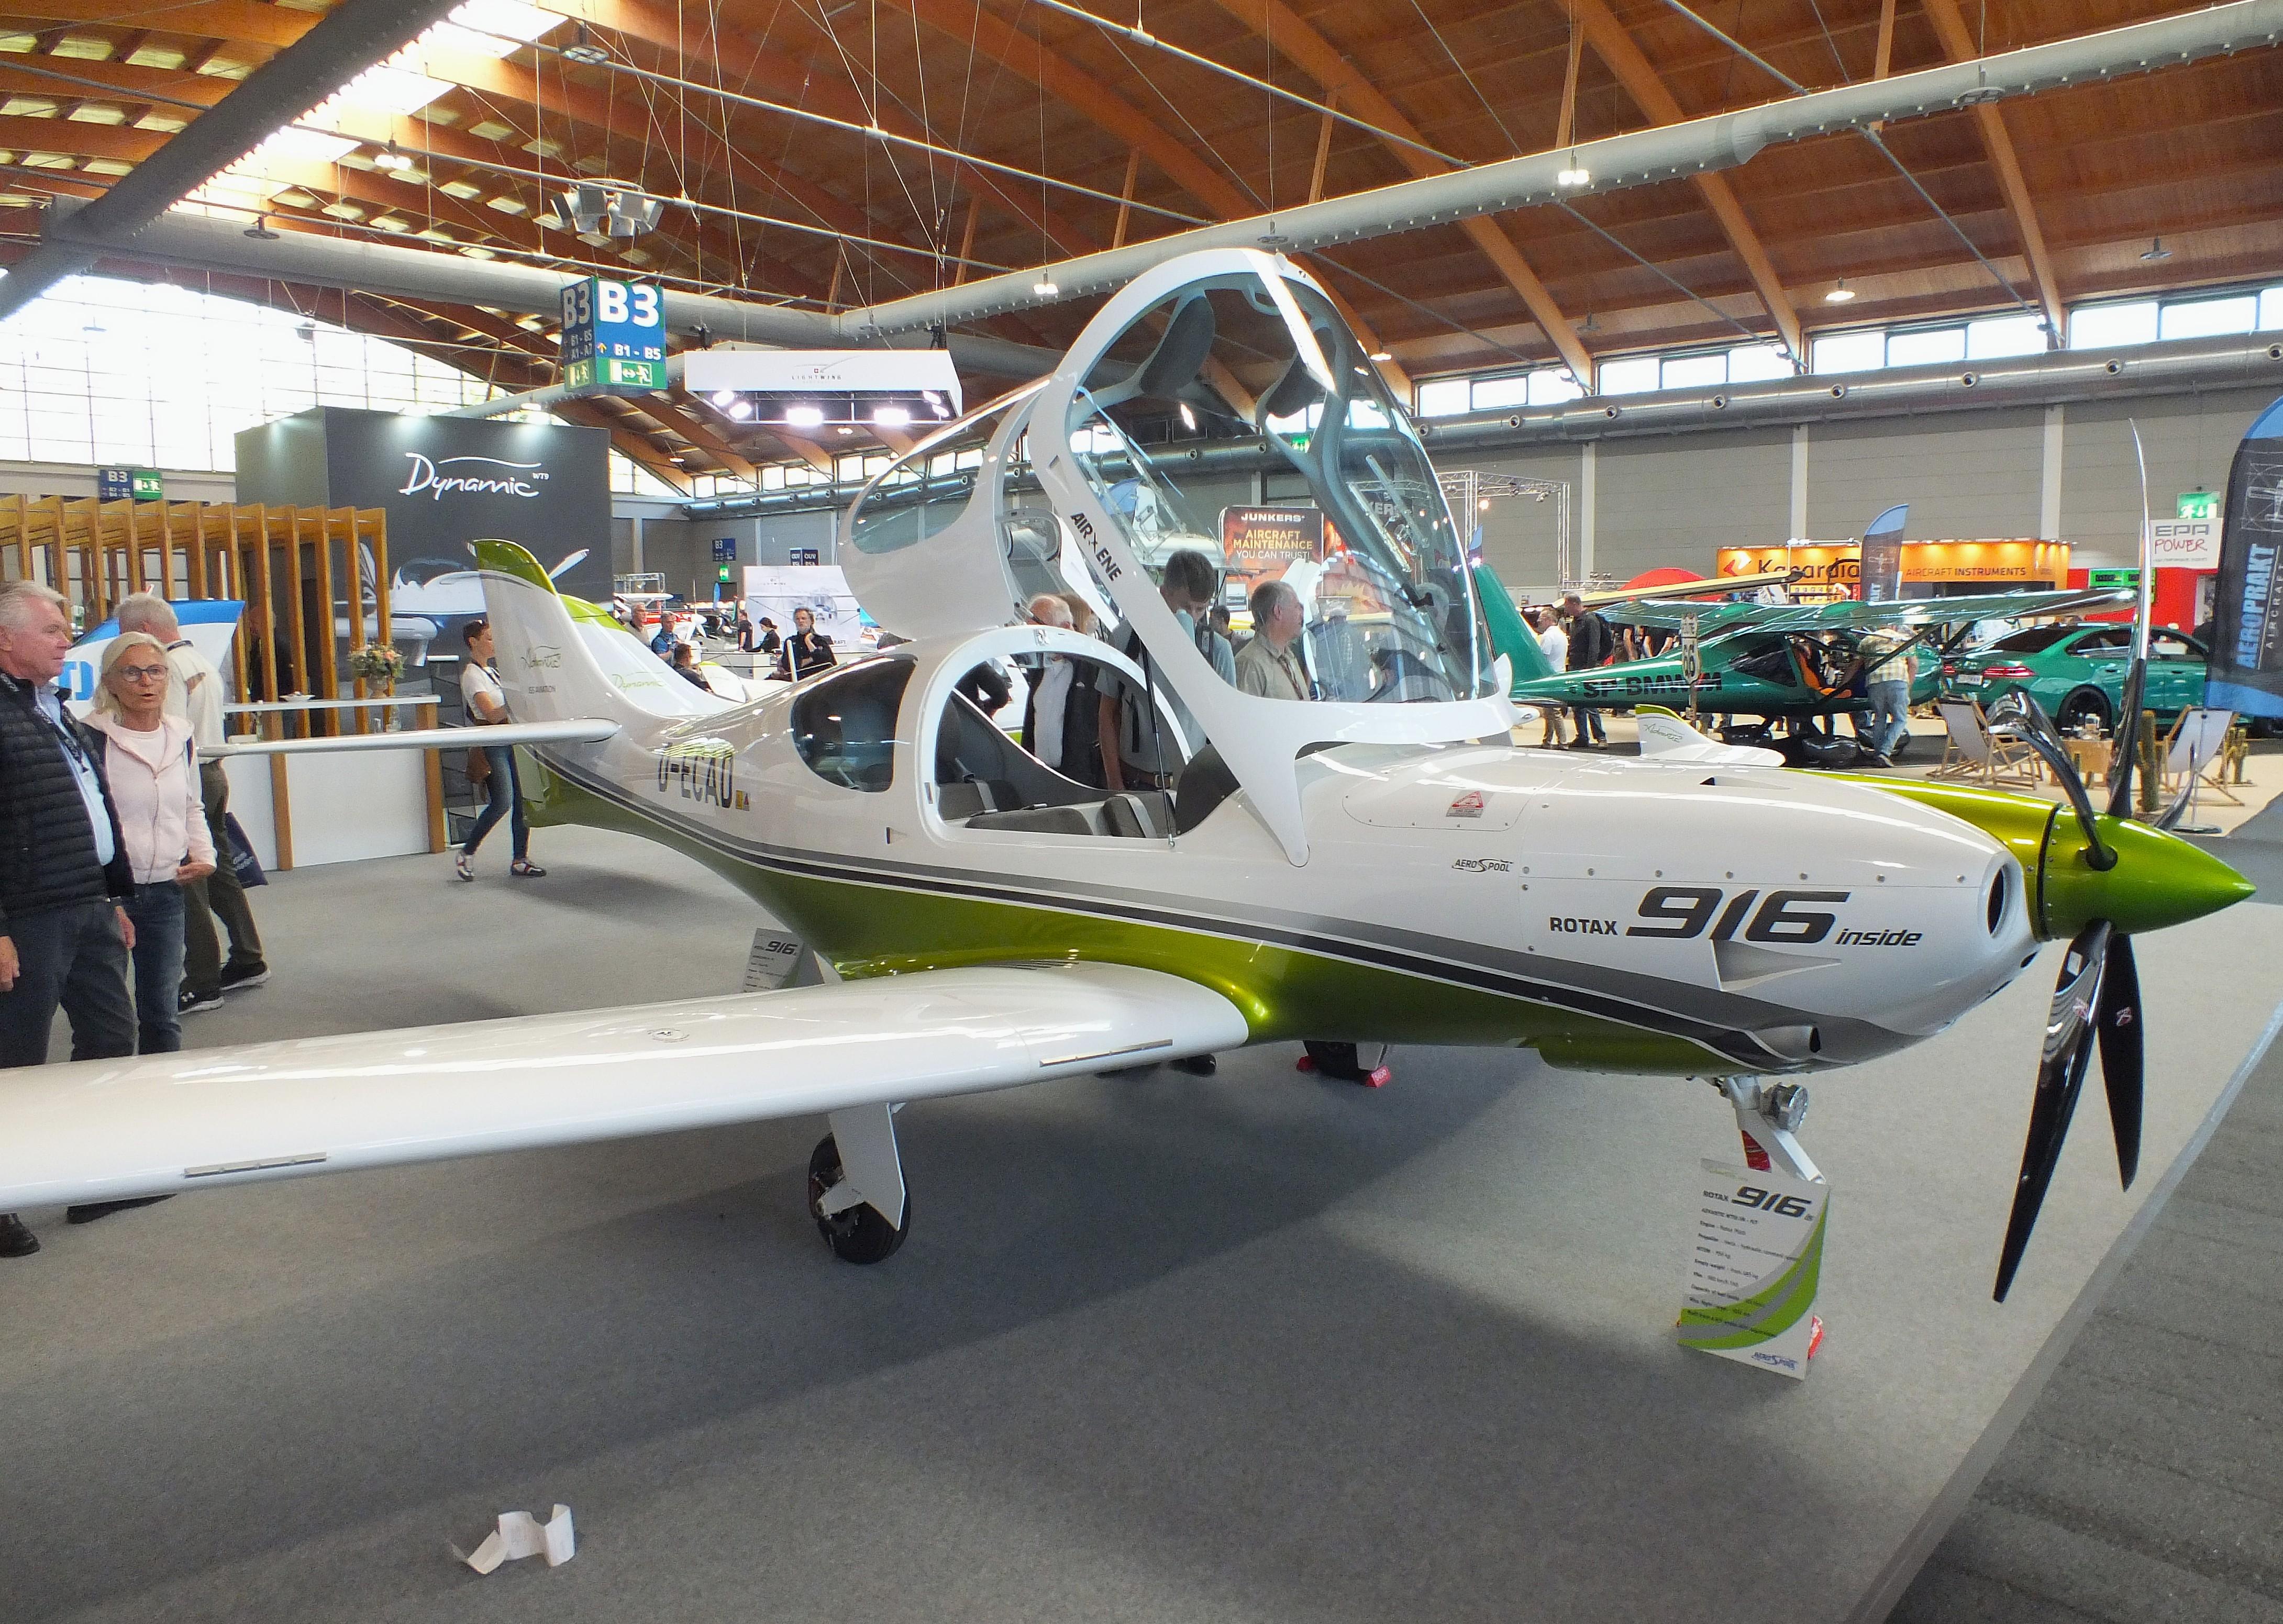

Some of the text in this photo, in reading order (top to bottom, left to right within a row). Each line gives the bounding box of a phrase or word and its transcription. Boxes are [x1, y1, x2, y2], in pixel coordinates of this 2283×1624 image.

[563, 283, 591, 329] B3
[599, 281, 659, 327] B3
[614, 343, 630, 357] B1
[644, 347, 661, 360] B5
[108, 471, 128, 483] B3
[398, 452, 539, 500] Dynamic
[1241, 513, 1302, 522] JUNKERS
[1246, 530, 1300, 540] AIRCRAFT
[2155, 524, 2209, 537] EPA
[715, 540, 723, 549] B3
[1233, 539, 1313, 550] MAINTENANCE
[2154, 539, 2208, 554] POWER
[1236, 550, 1310, 560] YOU CAN TRUST!
[1906, 568, 2026, 576] AIRCRAFT INSTRUMENTS
[2236, 543, 2274, 669] AEROPRAKT
[1549, 886, 1922, 947] ROTAX 916 inside
[766, 941, 798, 954] 916
[1732, 1186, 1812, 1218] 916
